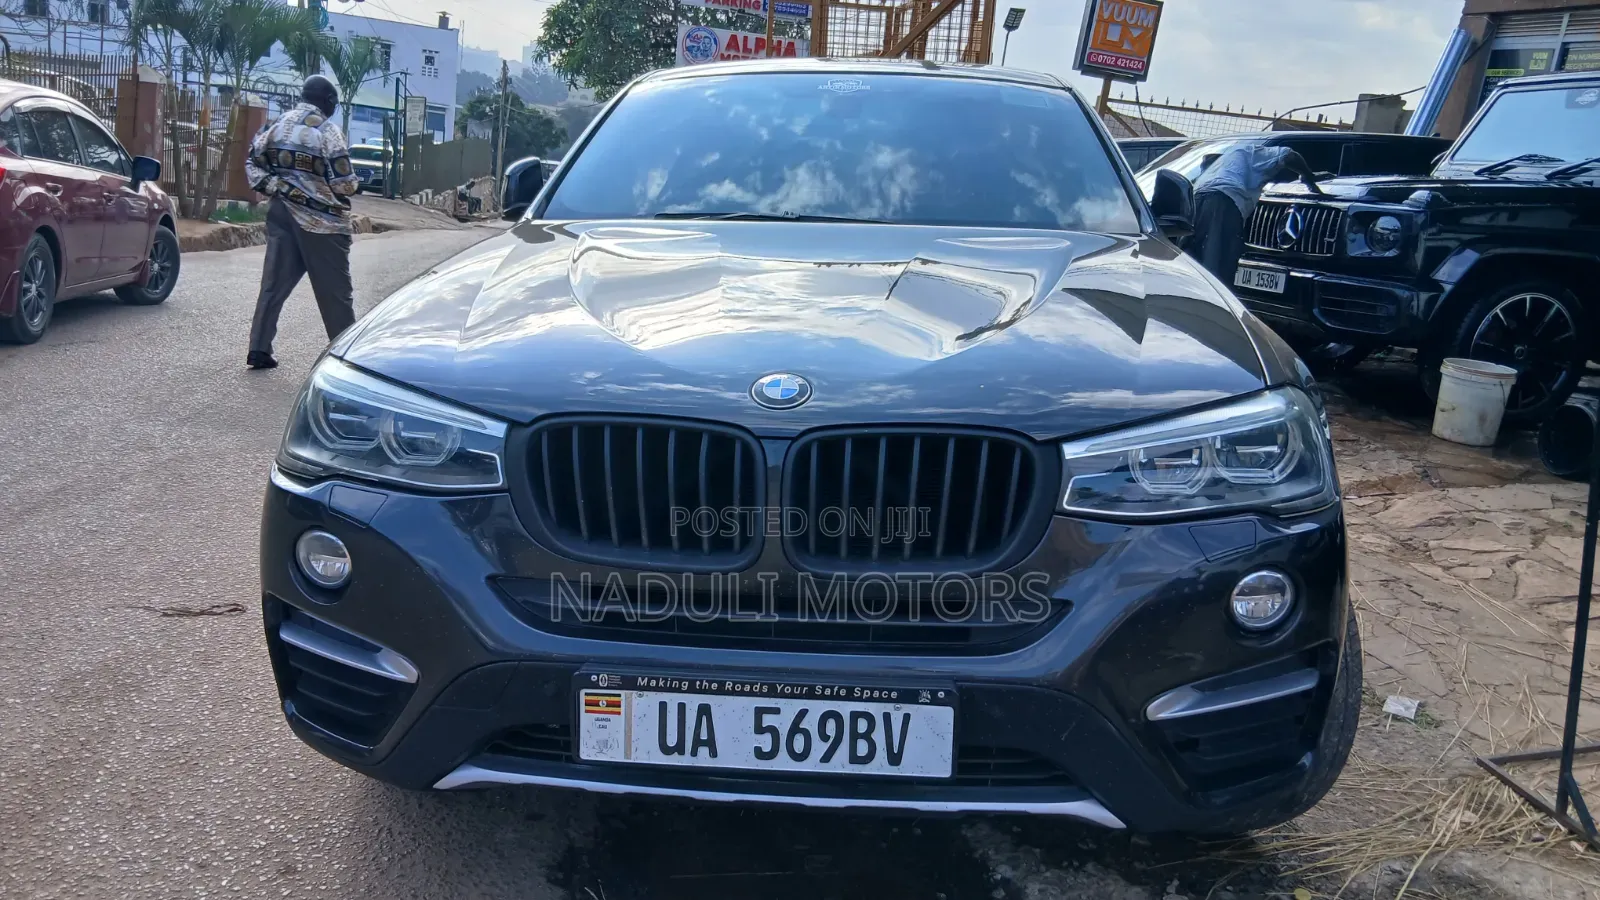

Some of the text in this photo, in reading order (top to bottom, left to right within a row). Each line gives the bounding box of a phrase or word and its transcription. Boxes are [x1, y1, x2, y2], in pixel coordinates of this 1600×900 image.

[1102, 0, 1155, 27] VUUM
[725, 34, 797, 56] ALPHA
[1098, 55, 1143, 69] 0702 421424
[1241, 270, 1252, 285] UA
[637, 677, 898, 699] Making the Roads Your Safe Space
[658, 701, 911, 766] UA 569BV
